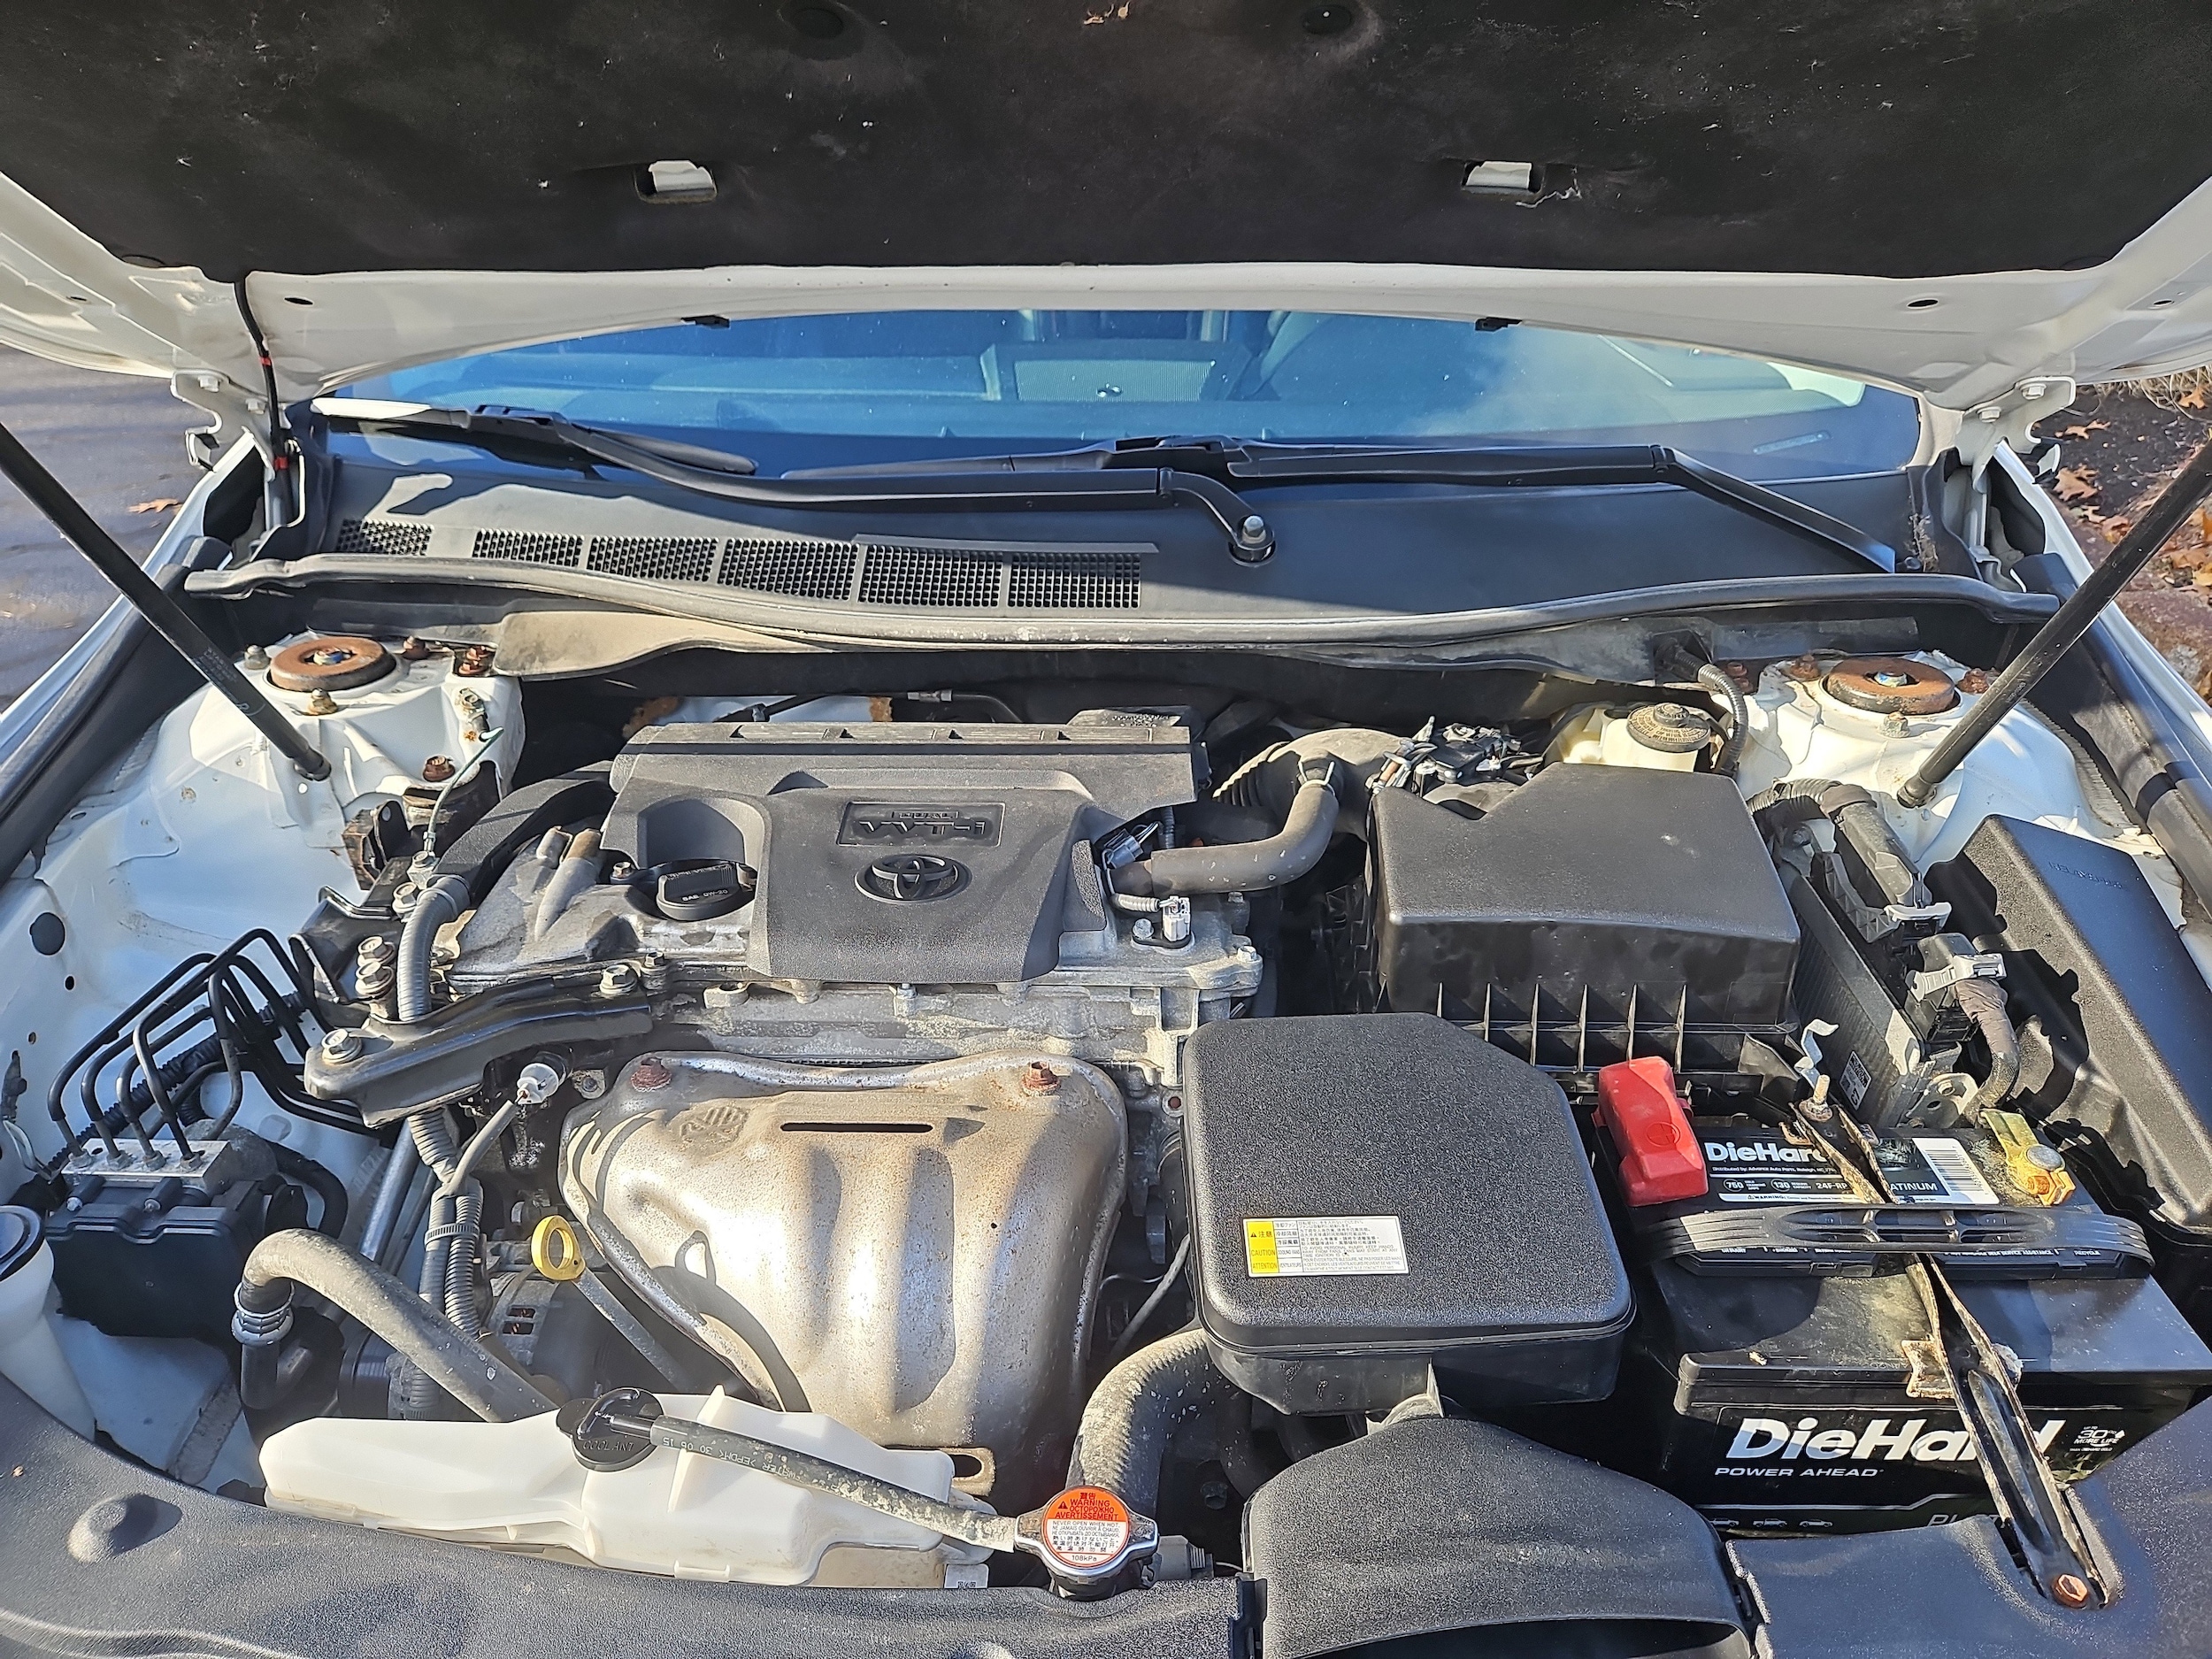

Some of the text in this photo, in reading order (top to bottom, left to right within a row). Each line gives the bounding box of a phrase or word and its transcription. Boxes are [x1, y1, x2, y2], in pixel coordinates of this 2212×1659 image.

[1890, 1182, 1938, 1191] ATINUM
[582, 1440, 635, 1451] COOLANT
[662, 1436, 674, 1447] 15
[680, 1440, 694, 1451] 06
[699, 1444, 713, 1455] 30
[1715, 1468, 1878, 1477] POWER AHEAD
[1070, 1505, 1114, 1514] ОСТОРОЖНО
[1056, 1511, 1118, 1521] AVERTISSEMENT
